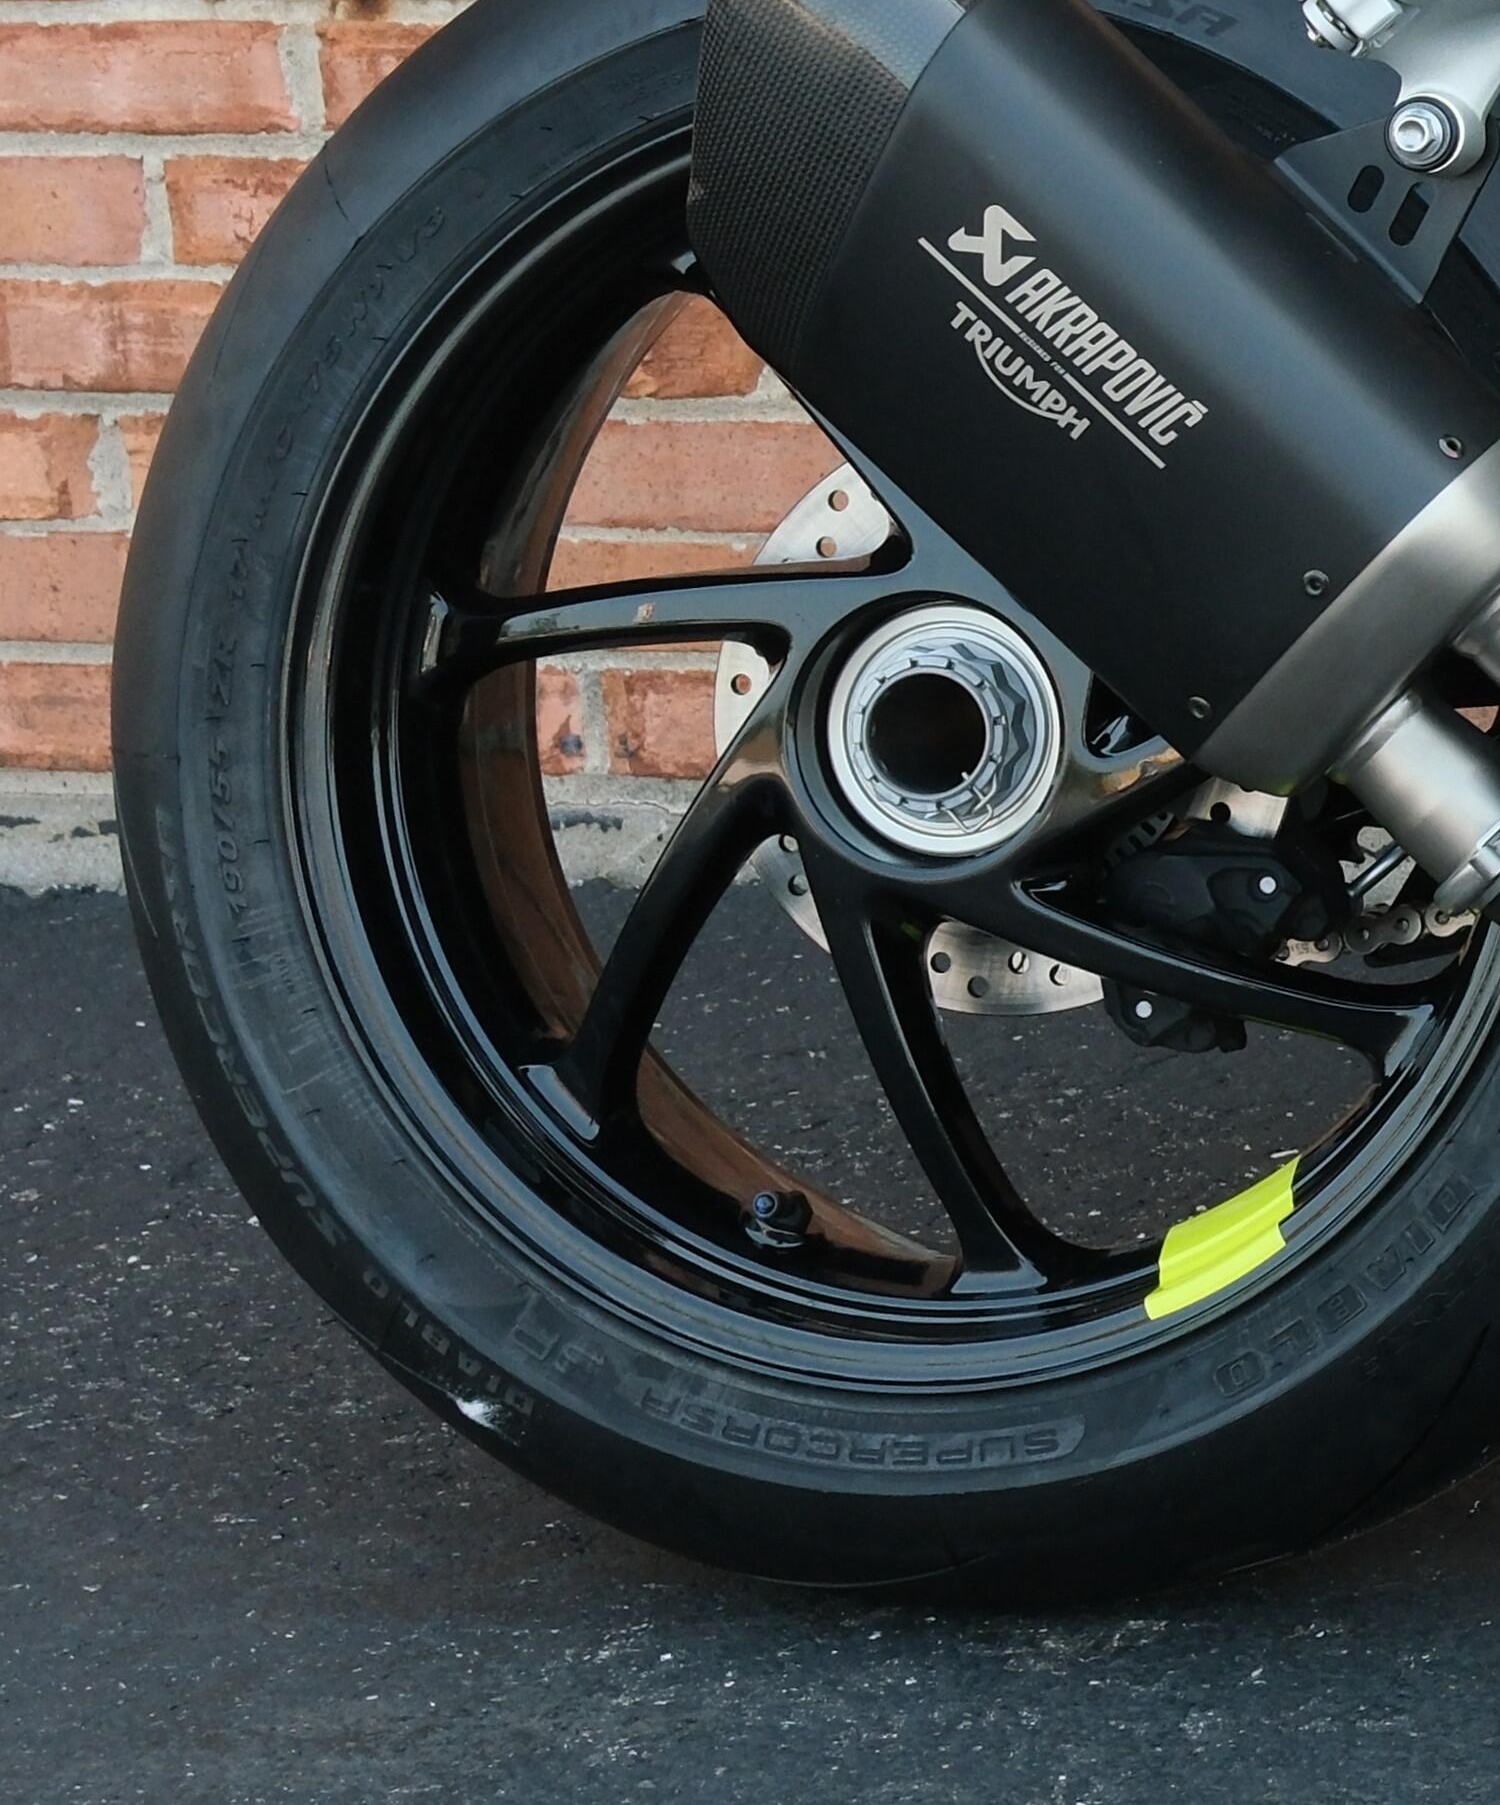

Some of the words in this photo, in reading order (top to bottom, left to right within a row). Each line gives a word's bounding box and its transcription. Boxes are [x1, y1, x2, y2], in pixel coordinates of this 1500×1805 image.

[950, 301, 1092, 441] TRIUMPH
[1205, 1169, 1483, 1403] DIABLO
[634, 1383, 1064, 1471] SUPERCORSA
